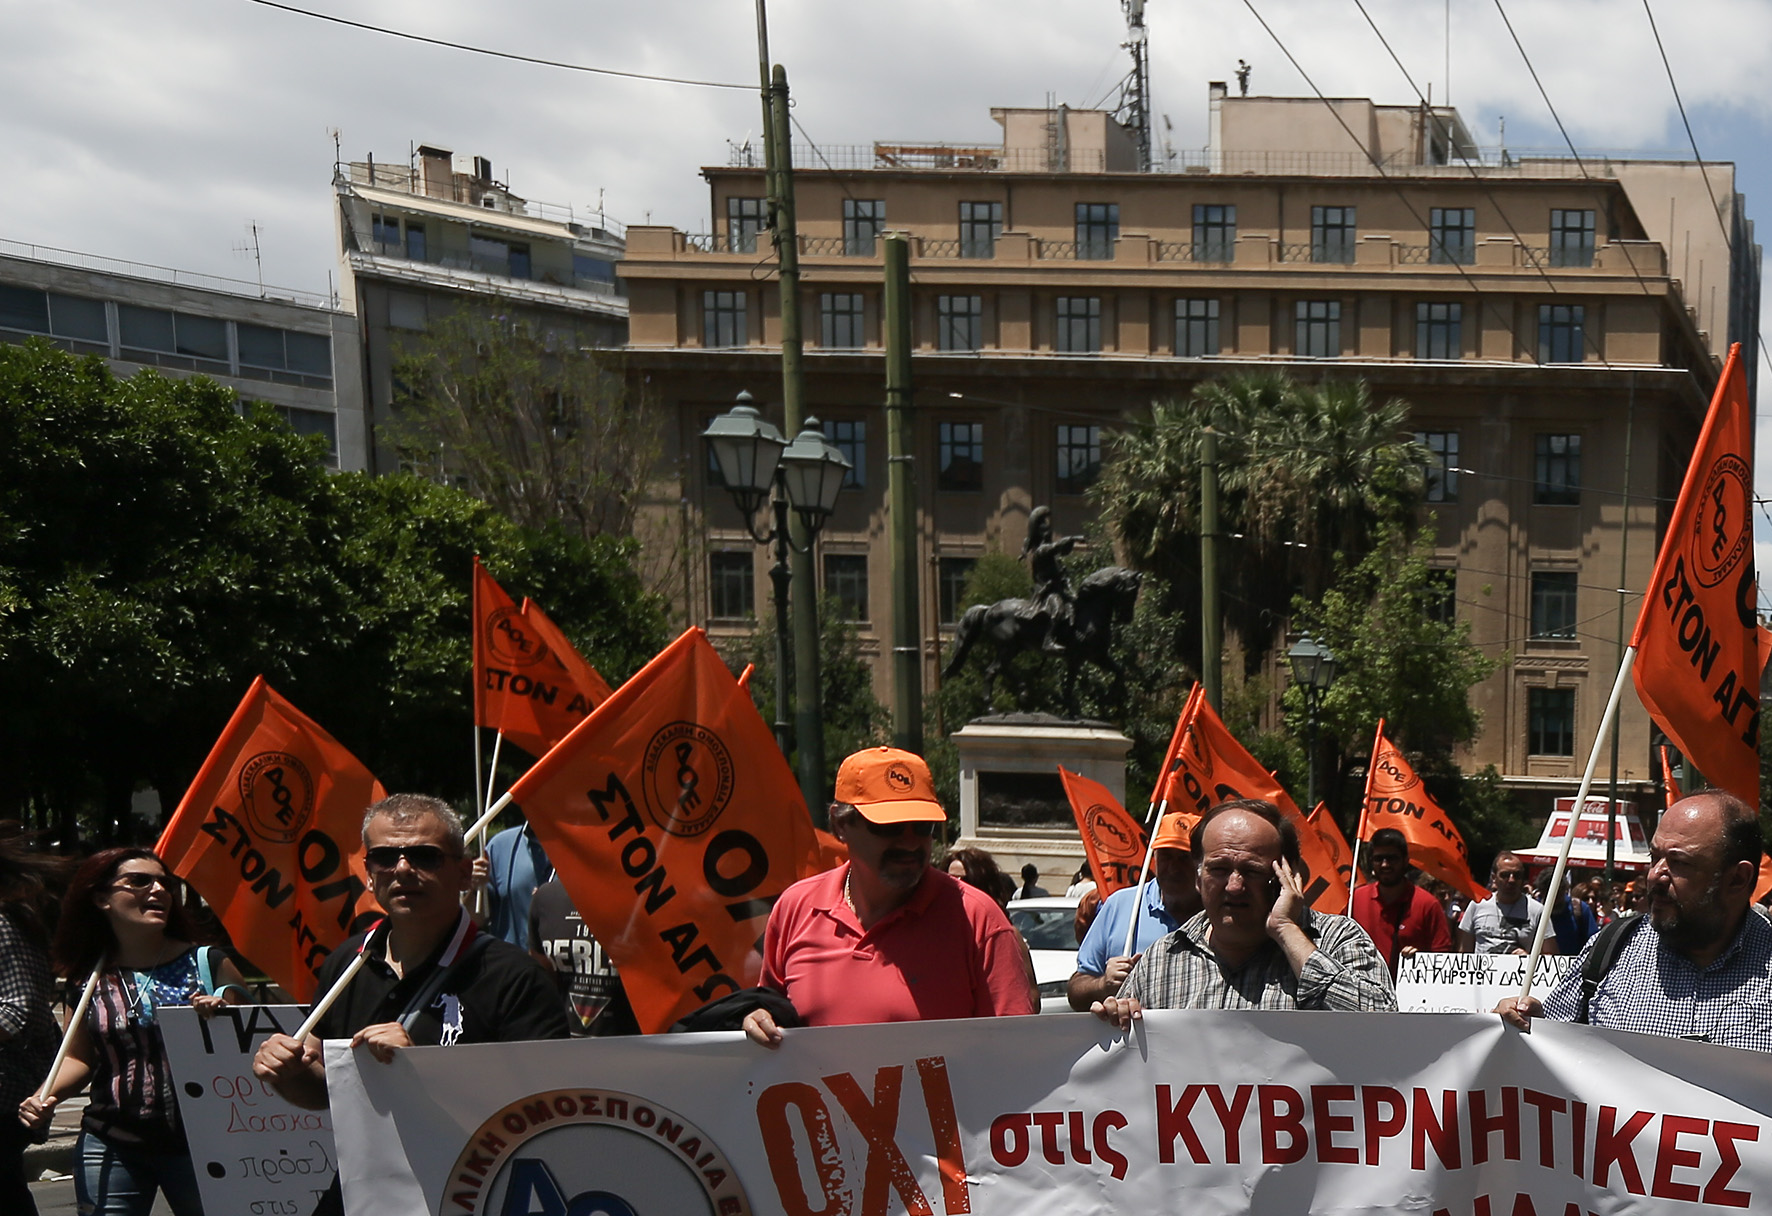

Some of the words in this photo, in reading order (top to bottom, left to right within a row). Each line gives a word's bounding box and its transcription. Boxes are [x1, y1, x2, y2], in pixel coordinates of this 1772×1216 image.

[1712, 479, 1728, 561] ΔΟΕ
[1663, 554, 1721, 682] ΣΤΟΝ
[264, 767, 295, 827] ΔΟΕ
[674, 742, 702, 816] ΔΟΕ
[1379, 761, 1407, 783] ΔΟΕ
[201, 806, 294, 909] ΣΤΟΝ
[290, 909, 333, 978] ΑΓΩ
[587, 771, 677, 916] ΣΤΟΝ
[659, 922, 743, 1003] ΑΓΩ
[1500, 970, 1563, 987] ΔΑΣΚΑΛ
[197, 1006, 313, 1054] ΠΑ
[212, 1075, 275, 1106] ορι
[239, 1140, 338, 1184] πρόσλ
[502, 1095, 727, 1191] ΟΜΟΣΠΟΝΔΙΑ
[989, 1107, 1129, 1181] στις
[1154, 1083, 1761, 1209] ΚΥΒΕΡΝΗΤΙΚΕΣ
